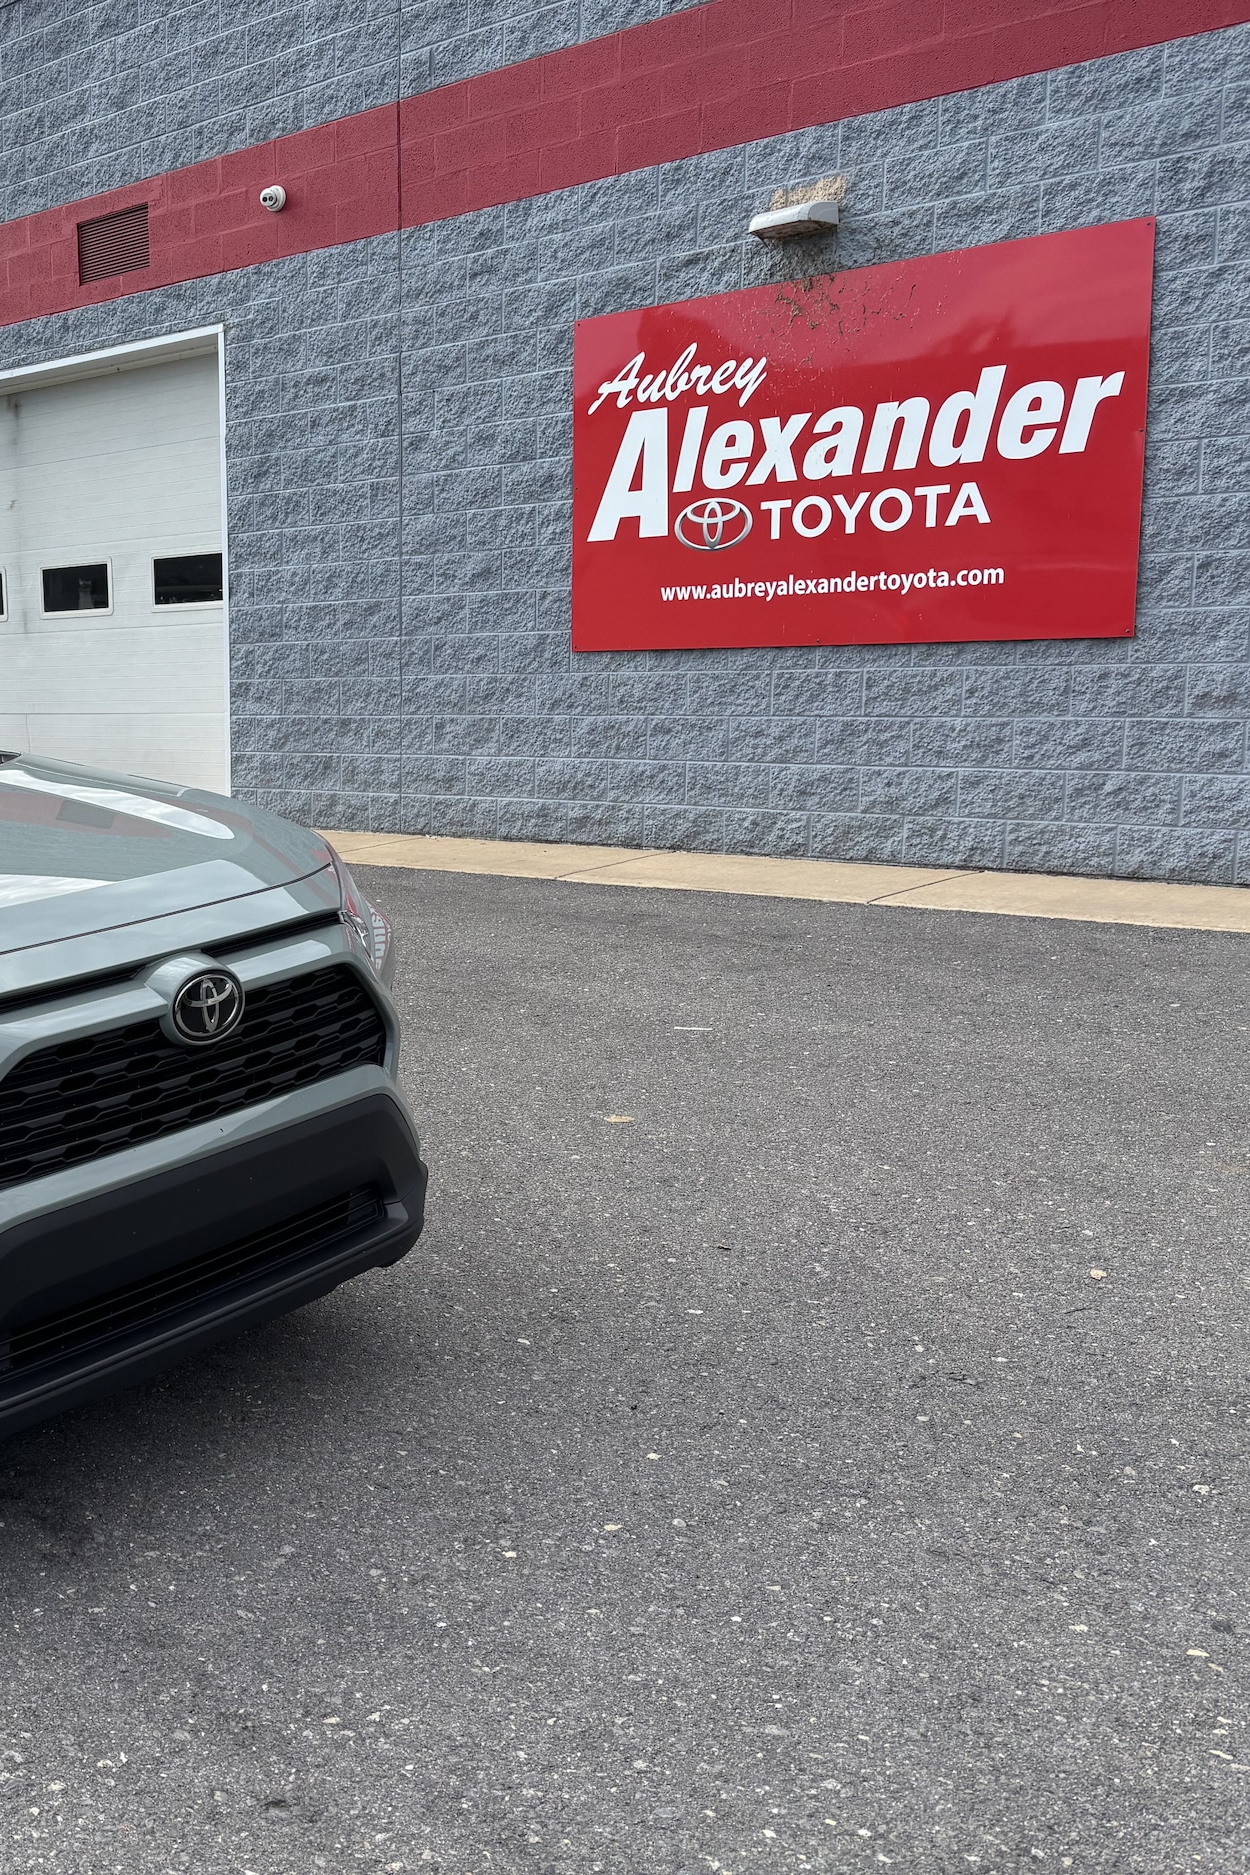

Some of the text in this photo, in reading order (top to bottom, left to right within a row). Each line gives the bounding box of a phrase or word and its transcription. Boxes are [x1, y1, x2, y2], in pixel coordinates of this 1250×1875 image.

[587, 342, 767, 415] Aubrey
[587, 364, 1125, 543] Alexander
[760, 481, 991, 540] TOYOTA
[660, 567, 1005, 602] www.aubreyalexandertoyota.com
